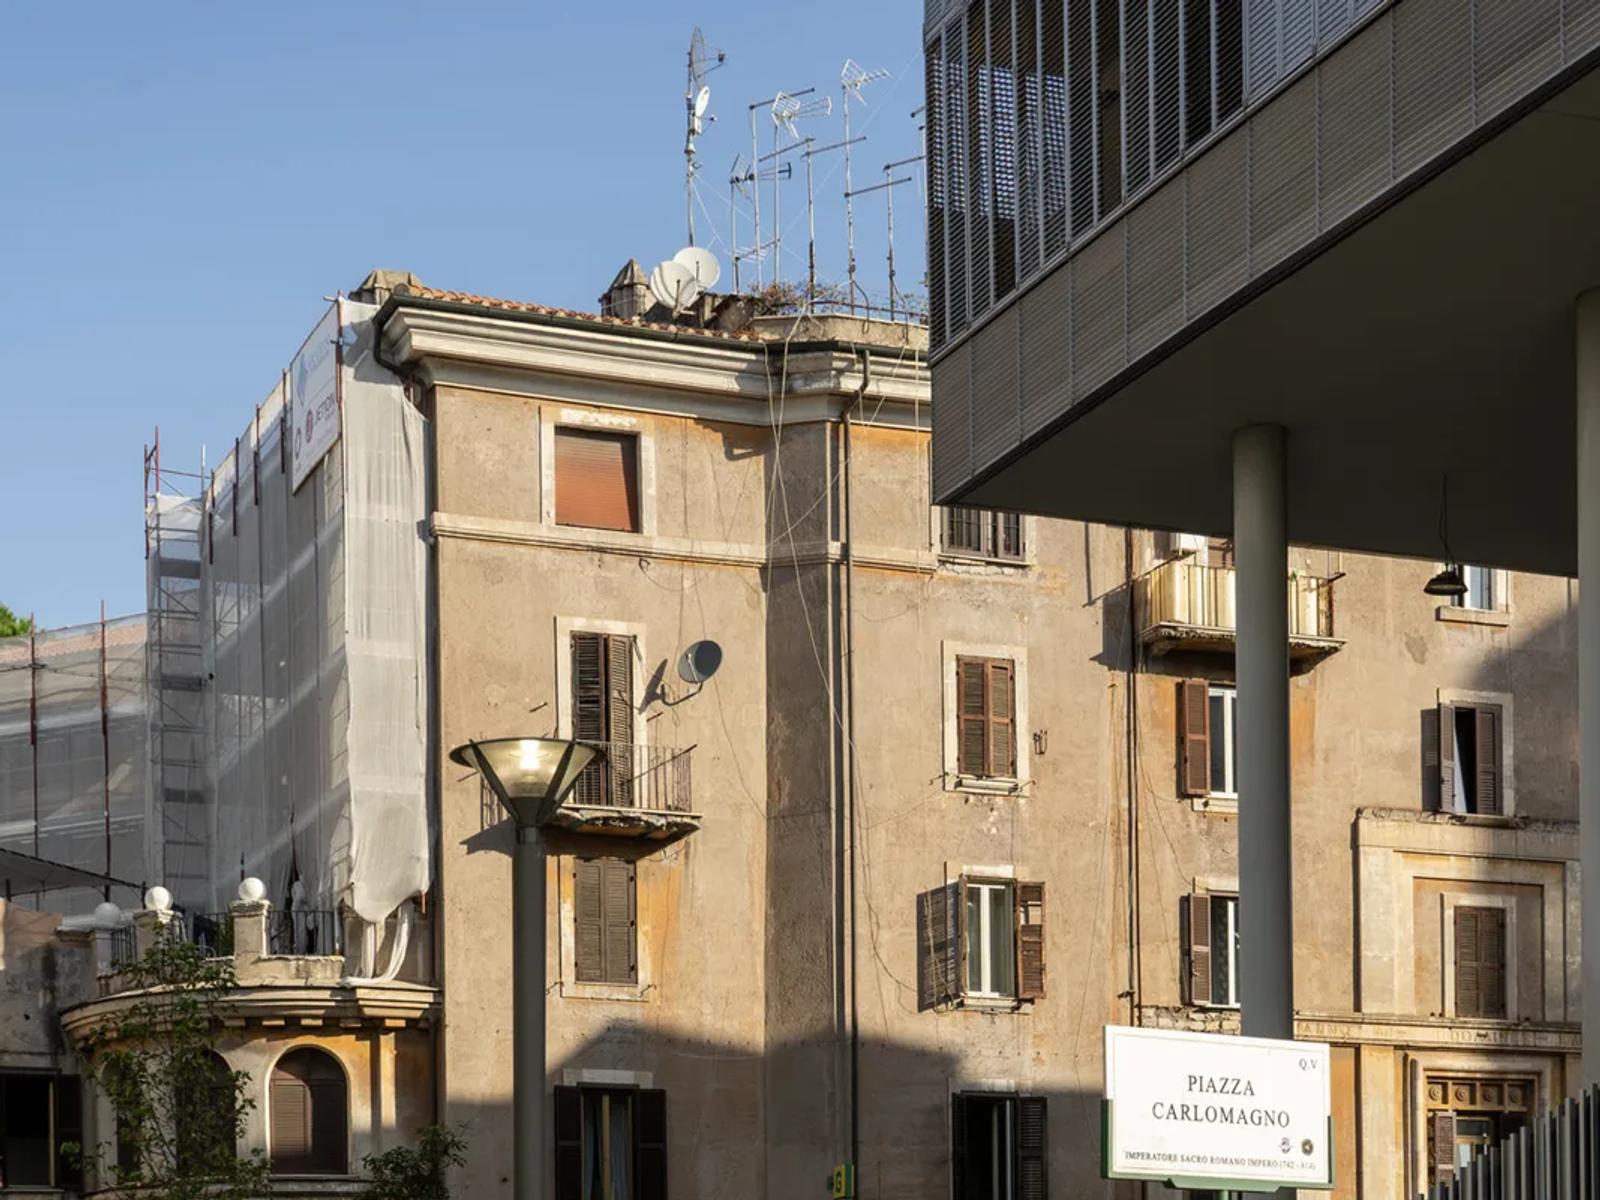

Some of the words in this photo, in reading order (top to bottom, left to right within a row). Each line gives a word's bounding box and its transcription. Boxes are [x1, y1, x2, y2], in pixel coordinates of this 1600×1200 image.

[1187, 1074, 1255, 1096] PIAZZA
[1151, 1102, 1290, 1128] CARLOMAGNO
[1125, 1151, 1178, 1162] IMPERATORE
[1180, 1153, 1208, 1164] SACRO
[1210, 1155, 1245, 1166] ROMANO
[1248, 1157, 1278, 1168] IMPERO
